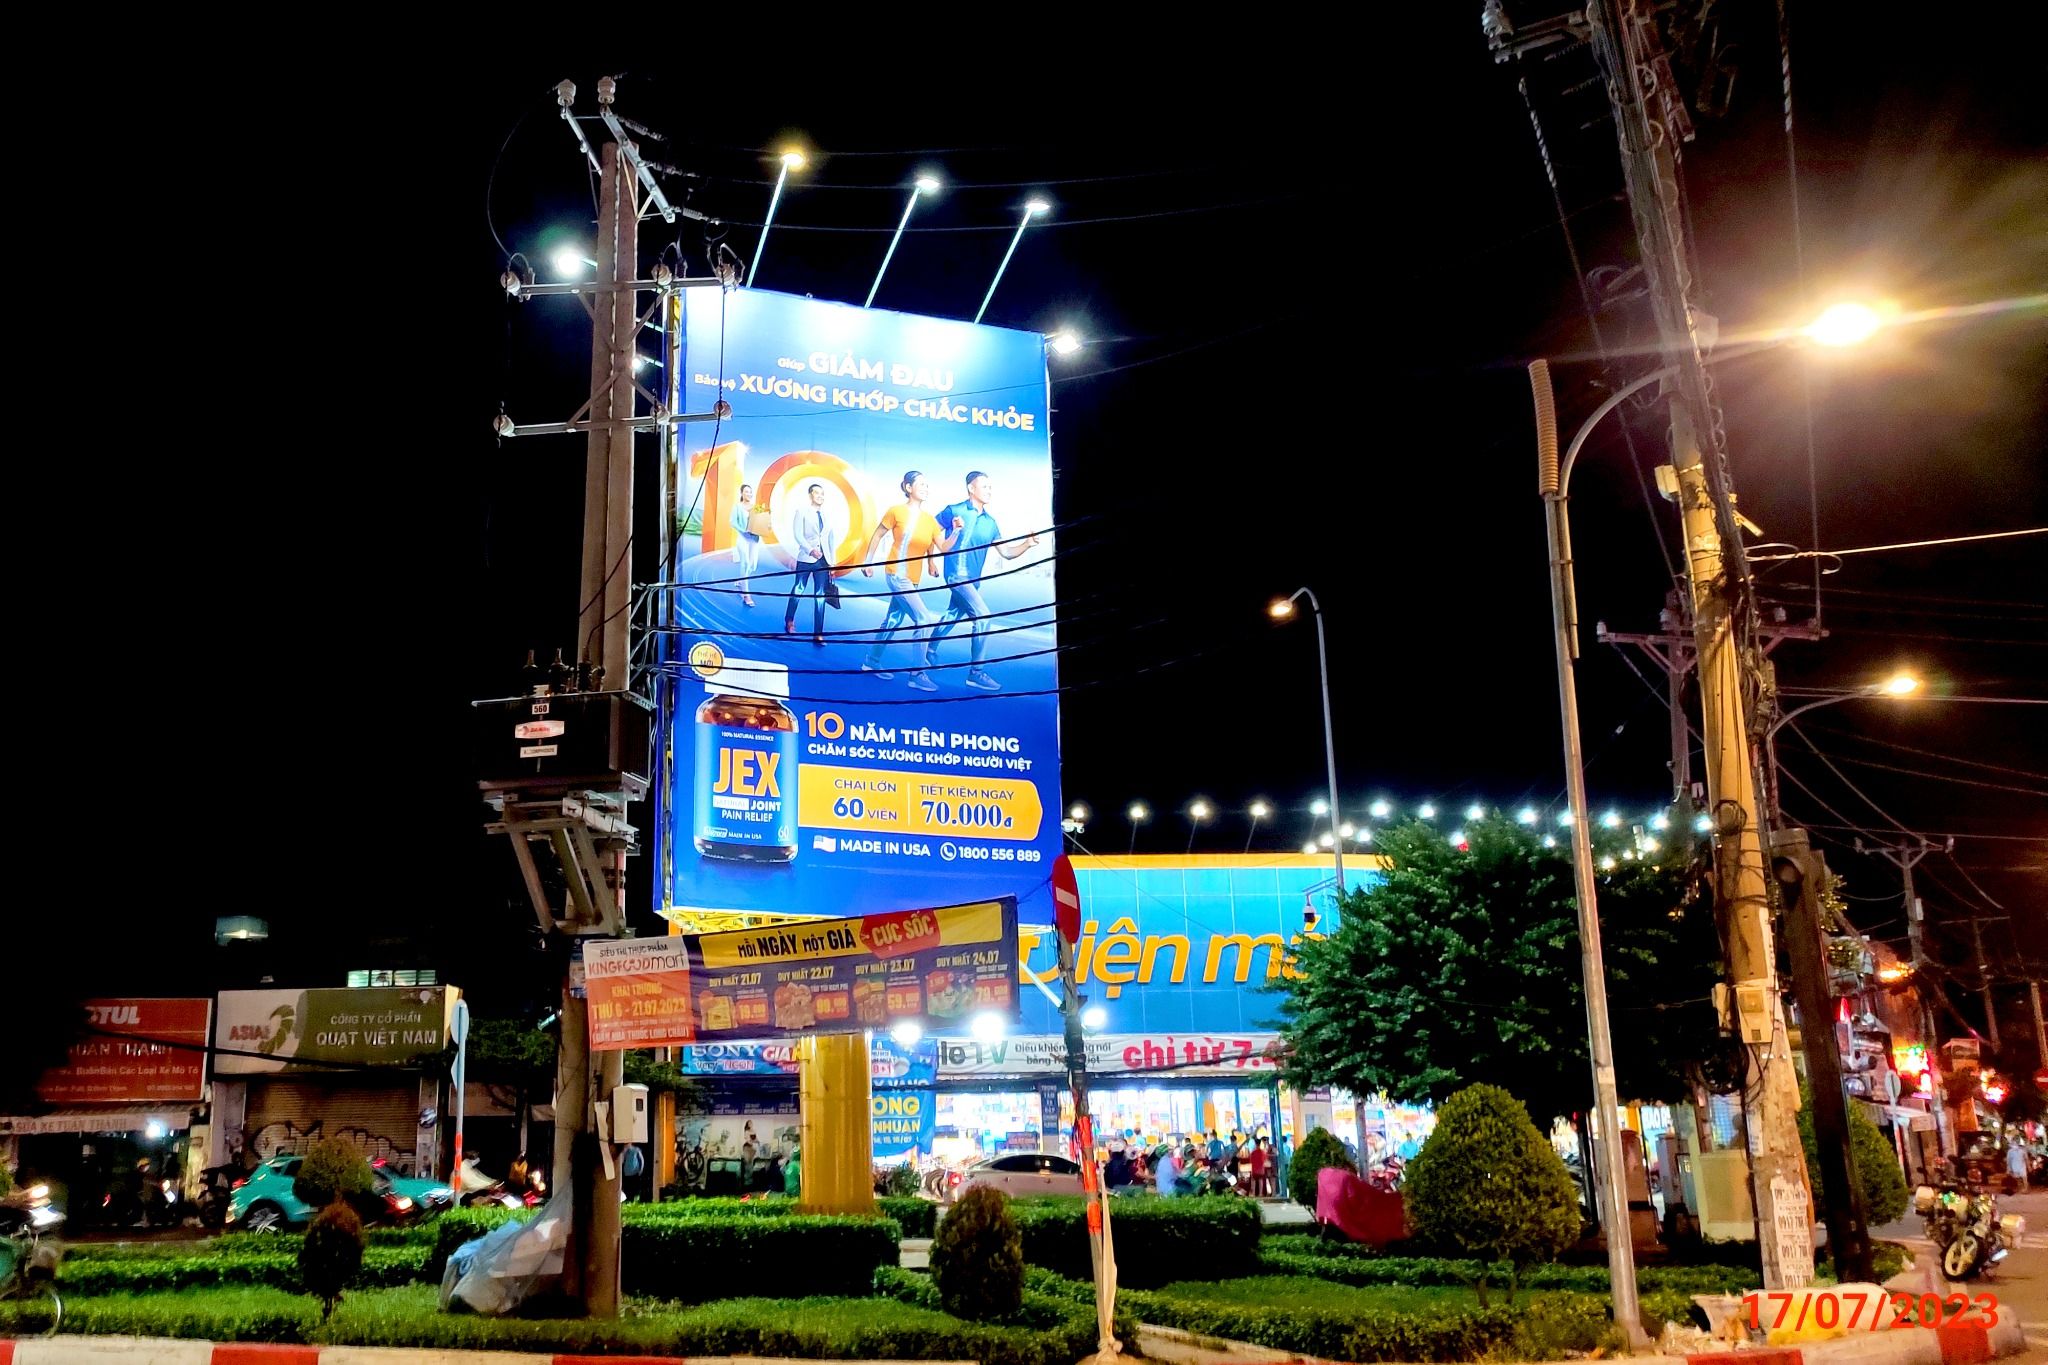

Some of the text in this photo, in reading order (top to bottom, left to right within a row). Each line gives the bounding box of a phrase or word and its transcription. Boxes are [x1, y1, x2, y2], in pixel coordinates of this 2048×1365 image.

[777, 349, 954, 392] Giúp GIẢM ĐAU
[739, 373, 827, 403] XƯƠNG
[832, 387, 899, 413] KHỚP
[903, 396, 969, 423] CHẮC
[971, 405, 1035, 432] KHỎE
[804, 711, 1020, 753] 10 NĂM TIÊN PHONG
[807, 742, 1032, 772] CHĂM SÓC XƯƠNG KHỚP NGƯỜI VIỆT
[713, 747, 781, 797] JEX
[834, 778, 897, 793] CHAI LỚN
[919, 782, 1014, 800] TIẾT KIỆM NGAY
[751, 800, 781, 811] JOINT
[833, 797, 897, 820] 60 VIÊN
[721, 809, 773, 822] PAIN RELIEF
[840, 838, 931, 856] MADE IN USA
[959, 846, 1041, 862] 1800 556 889
[871, 910, 934, 951] CỰC SỐC
[738, 923, 857, 958] MỖI NGÀY MỘT GIÁ
[890, 958, 915, 972] 23.07
[972, 950, 999, 966] 24.07
[740, 972, 762, 985] 21.07
[810, 966, 834, 980] 22.07
[330, 1010, 421, 1025] CÔNG TY CỔ PHẦN
[316, 1027, 437, 1048] QUẠT VIỆT NAM
[691, 1045, 757, 1057] SONY
[1122, 1036, 1176, 1069] chỉ
[1183, 1037, 1226, 1067] từ
